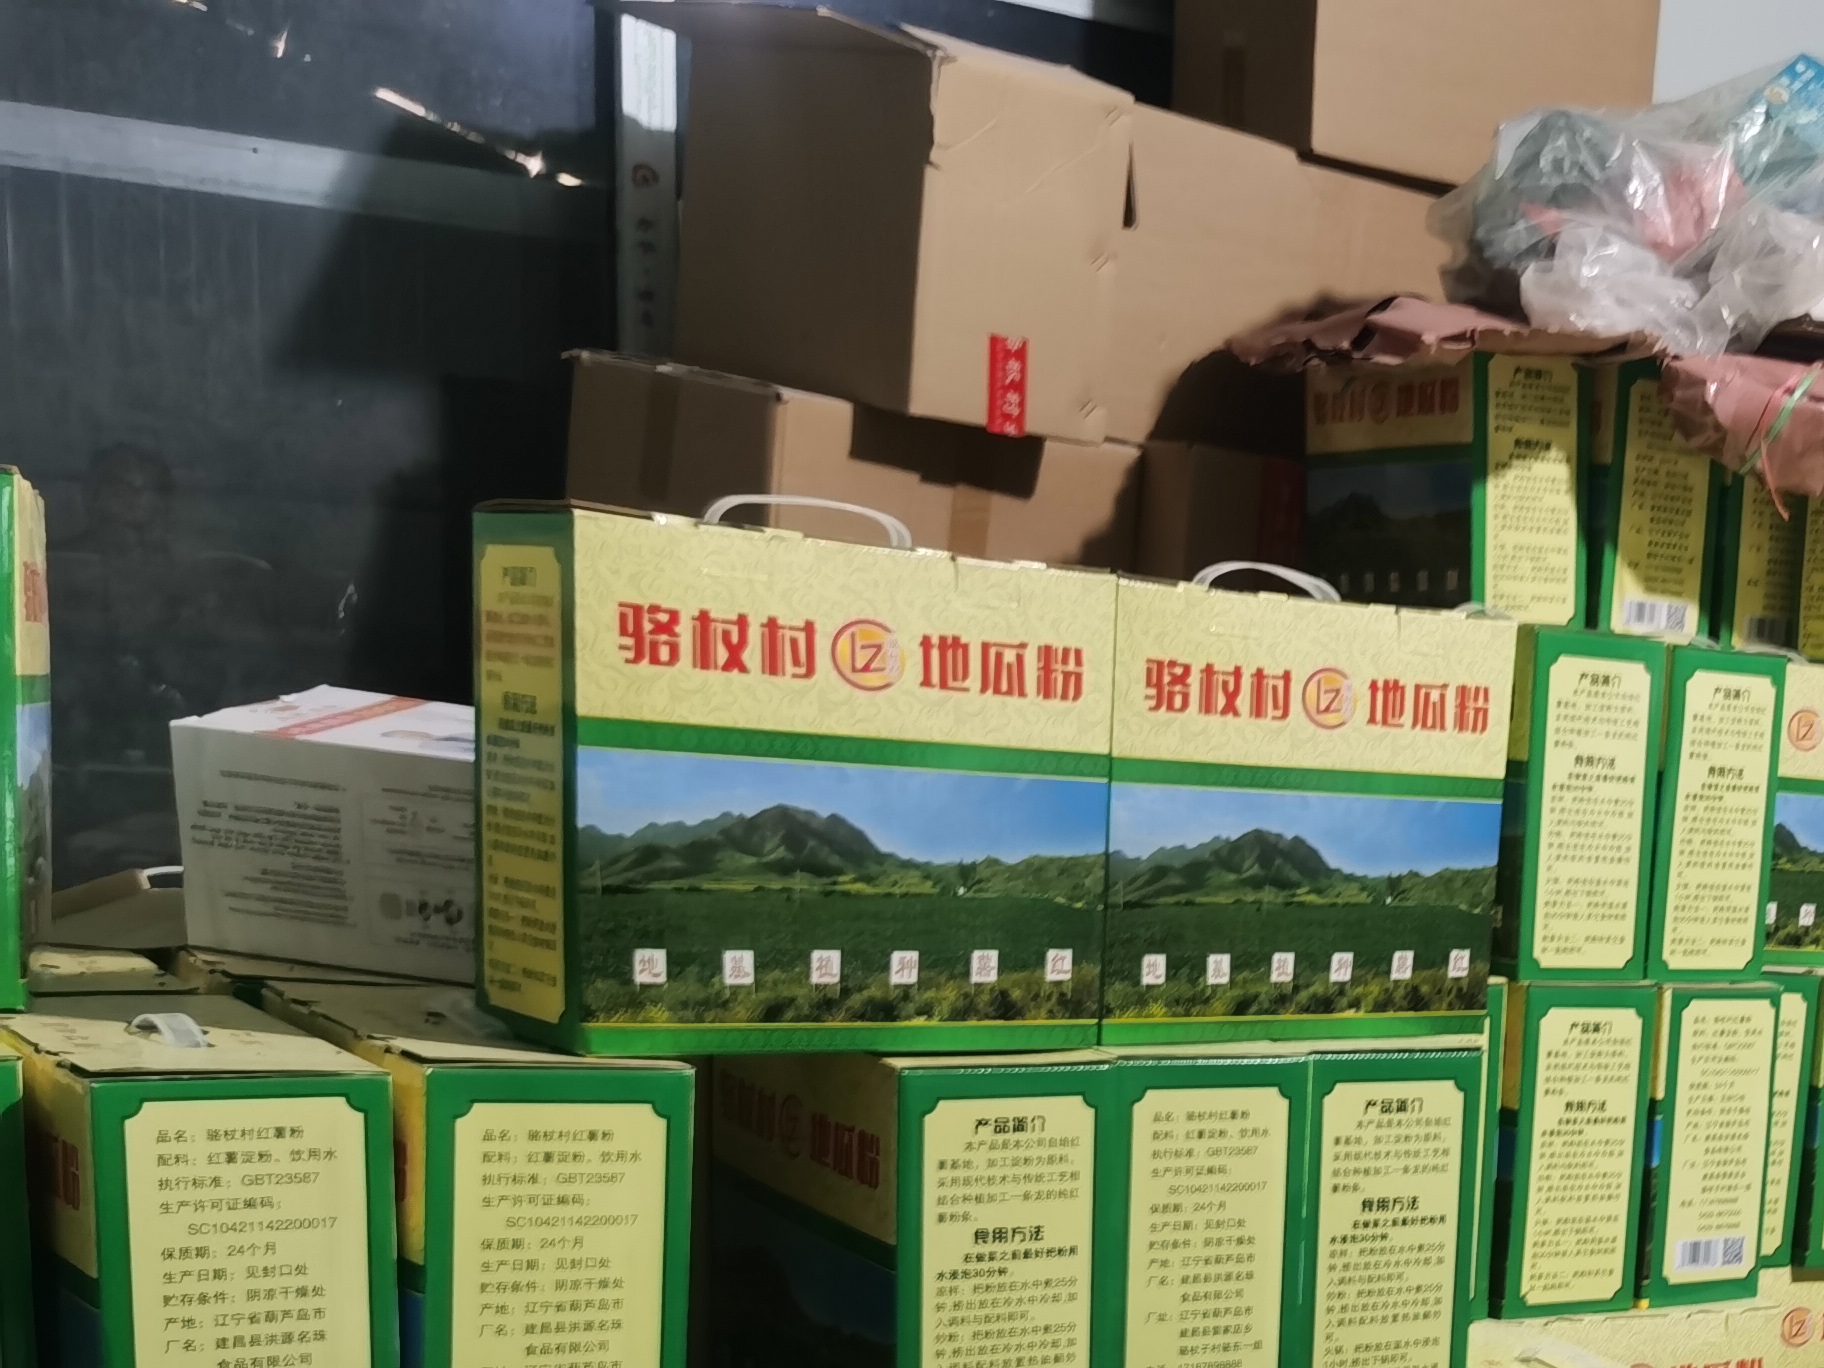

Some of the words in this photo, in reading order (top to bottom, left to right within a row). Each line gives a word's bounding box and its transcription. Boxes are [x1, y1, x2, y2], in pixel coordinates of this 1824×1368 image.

[617, 600, 817, 679] 骆杖村
[919, 633, 1084, 702] 地瓜粉
[1145, 658, 1292, 721] 骆杖村
[1366, 678, 1491, 735] 地瓜粉
[973, 1115, 1045, 1135] 产品简介
[972, 1224, 1044, 1246] 食用方法
